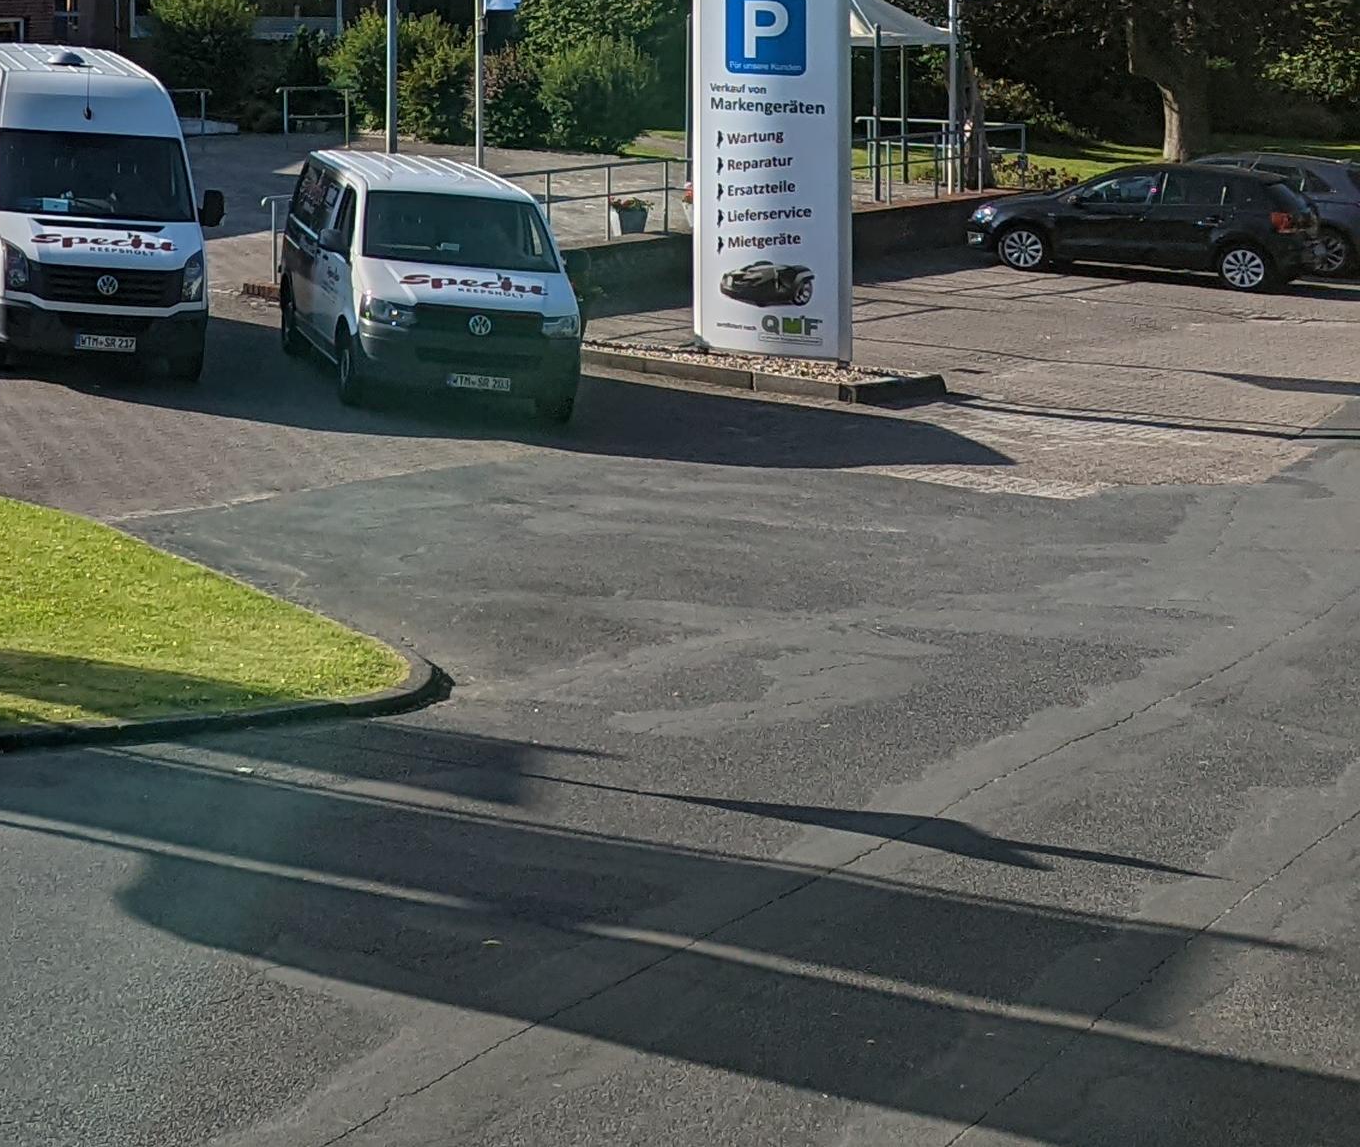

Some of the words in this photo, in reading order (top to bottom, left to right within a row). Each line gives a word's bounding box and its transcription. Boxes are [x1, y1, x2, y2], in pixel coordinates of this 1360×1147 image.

[744, 0, 789, 59] P
[710, 83, 746, 94] Verkauf
[748, 85, 767, 94] von
[710, 97, 825, 116] Markengeräten
[727, 130, 784, 144] Wartung
[727, 155, 794, 172] Reparatur
[727, 180, 796, 197] Ersatzteile
[727, 206, 812, 222] Lieferservice
[31, 233, 178, 252] Specht
[727, 232, 801, 249] Mietgeräte
[399, 274, 548, 295] Specht
